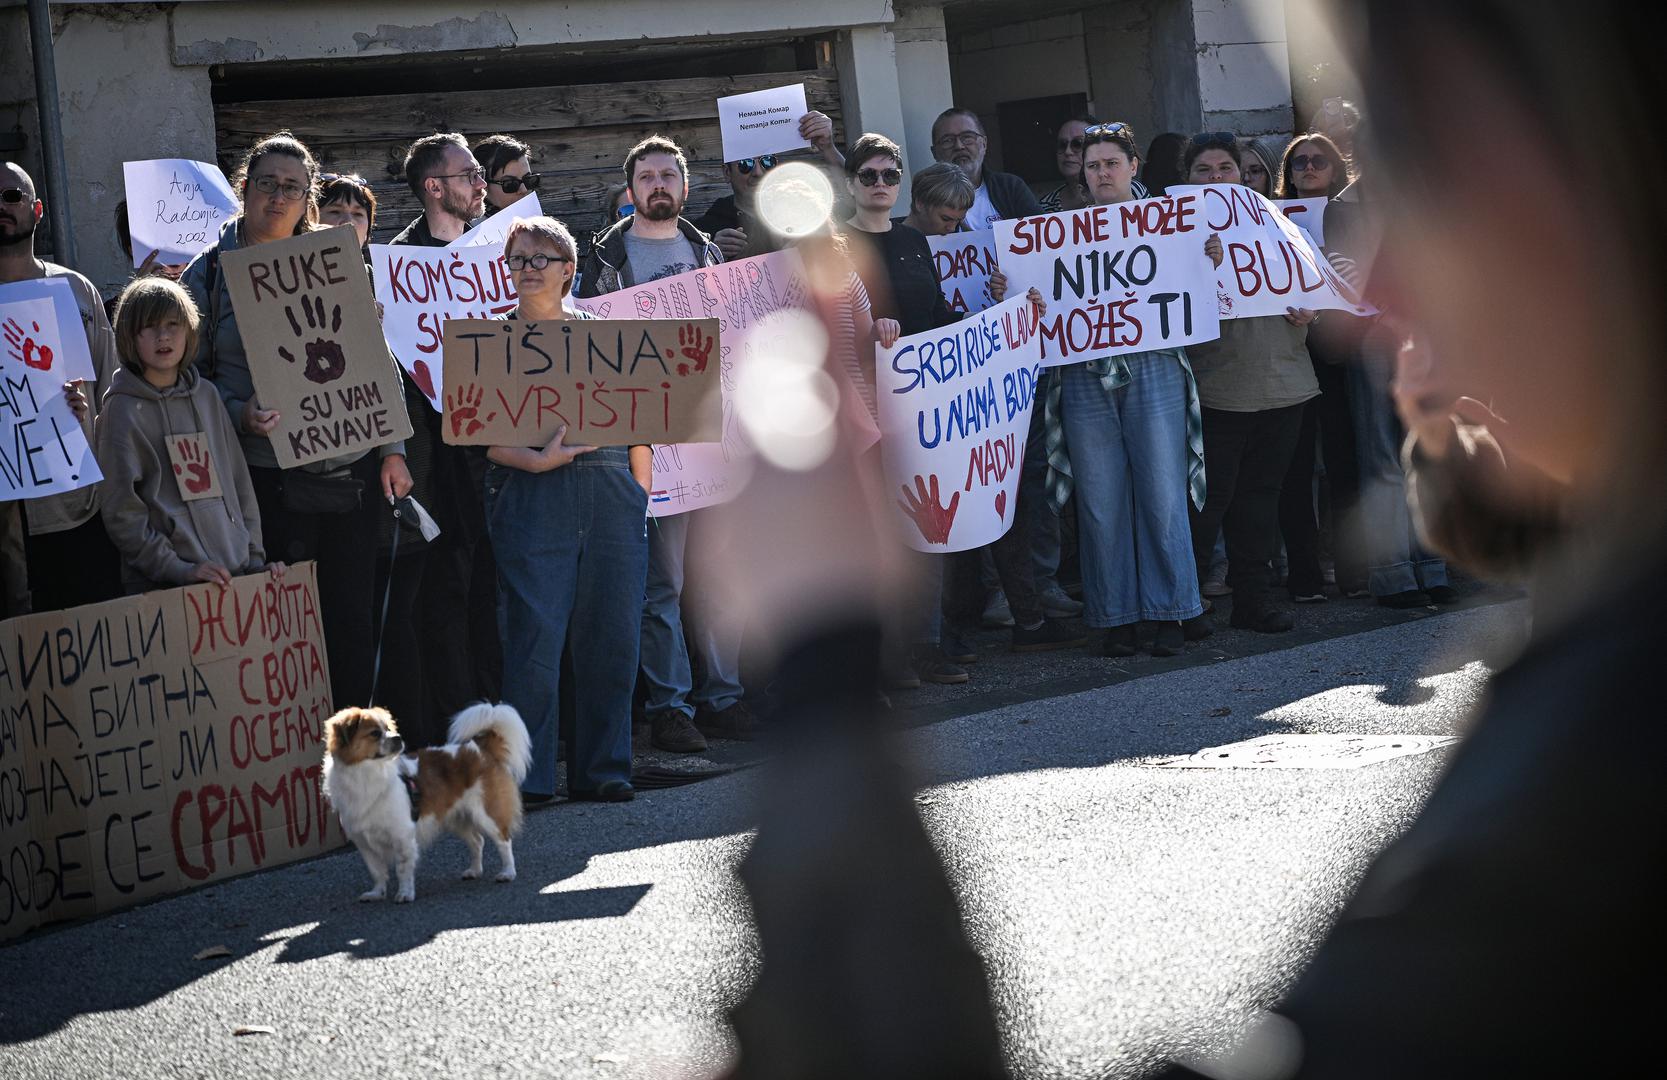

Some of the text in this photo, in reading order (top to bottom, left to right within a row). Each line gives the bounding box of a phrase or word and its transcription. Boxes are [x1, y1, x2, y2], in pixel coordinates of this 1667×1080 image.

[738, 105, 790, 119] Немања Комар
[739, 117, 792, 131] Nemanja Komar
[169, 170, 204, 200] Anja
[155, 199, 220, 228] Radonjić
[175, 231, 208, 245] 2002
[1008, 216, 1067, 255] ŠTO
[1072, 207, 1110, 245] NE
[1118, 194, 1197, 239] MOŽE
[247, 245, 349, 303] RUKE
[388, 251, 519, 304] KOMŠIJE
[1039, 291, 1193, 360] MOŽEŠ TI
[299, 381, 383, 422] SU VAM
[945, 376, 1001, 442] NAMA
[287, 409, 394, 460] KRVAVE
[186, 582, 321, 656] ЖИВОТА
[0, 641, 325, 758] АМА БИТНА СВОТА
[0, 738, 162, 833] ОЗНАЈЕТЕ
[172, 722, 219, 781] ЛИ
[104, 810, 165, 895] СЕ
